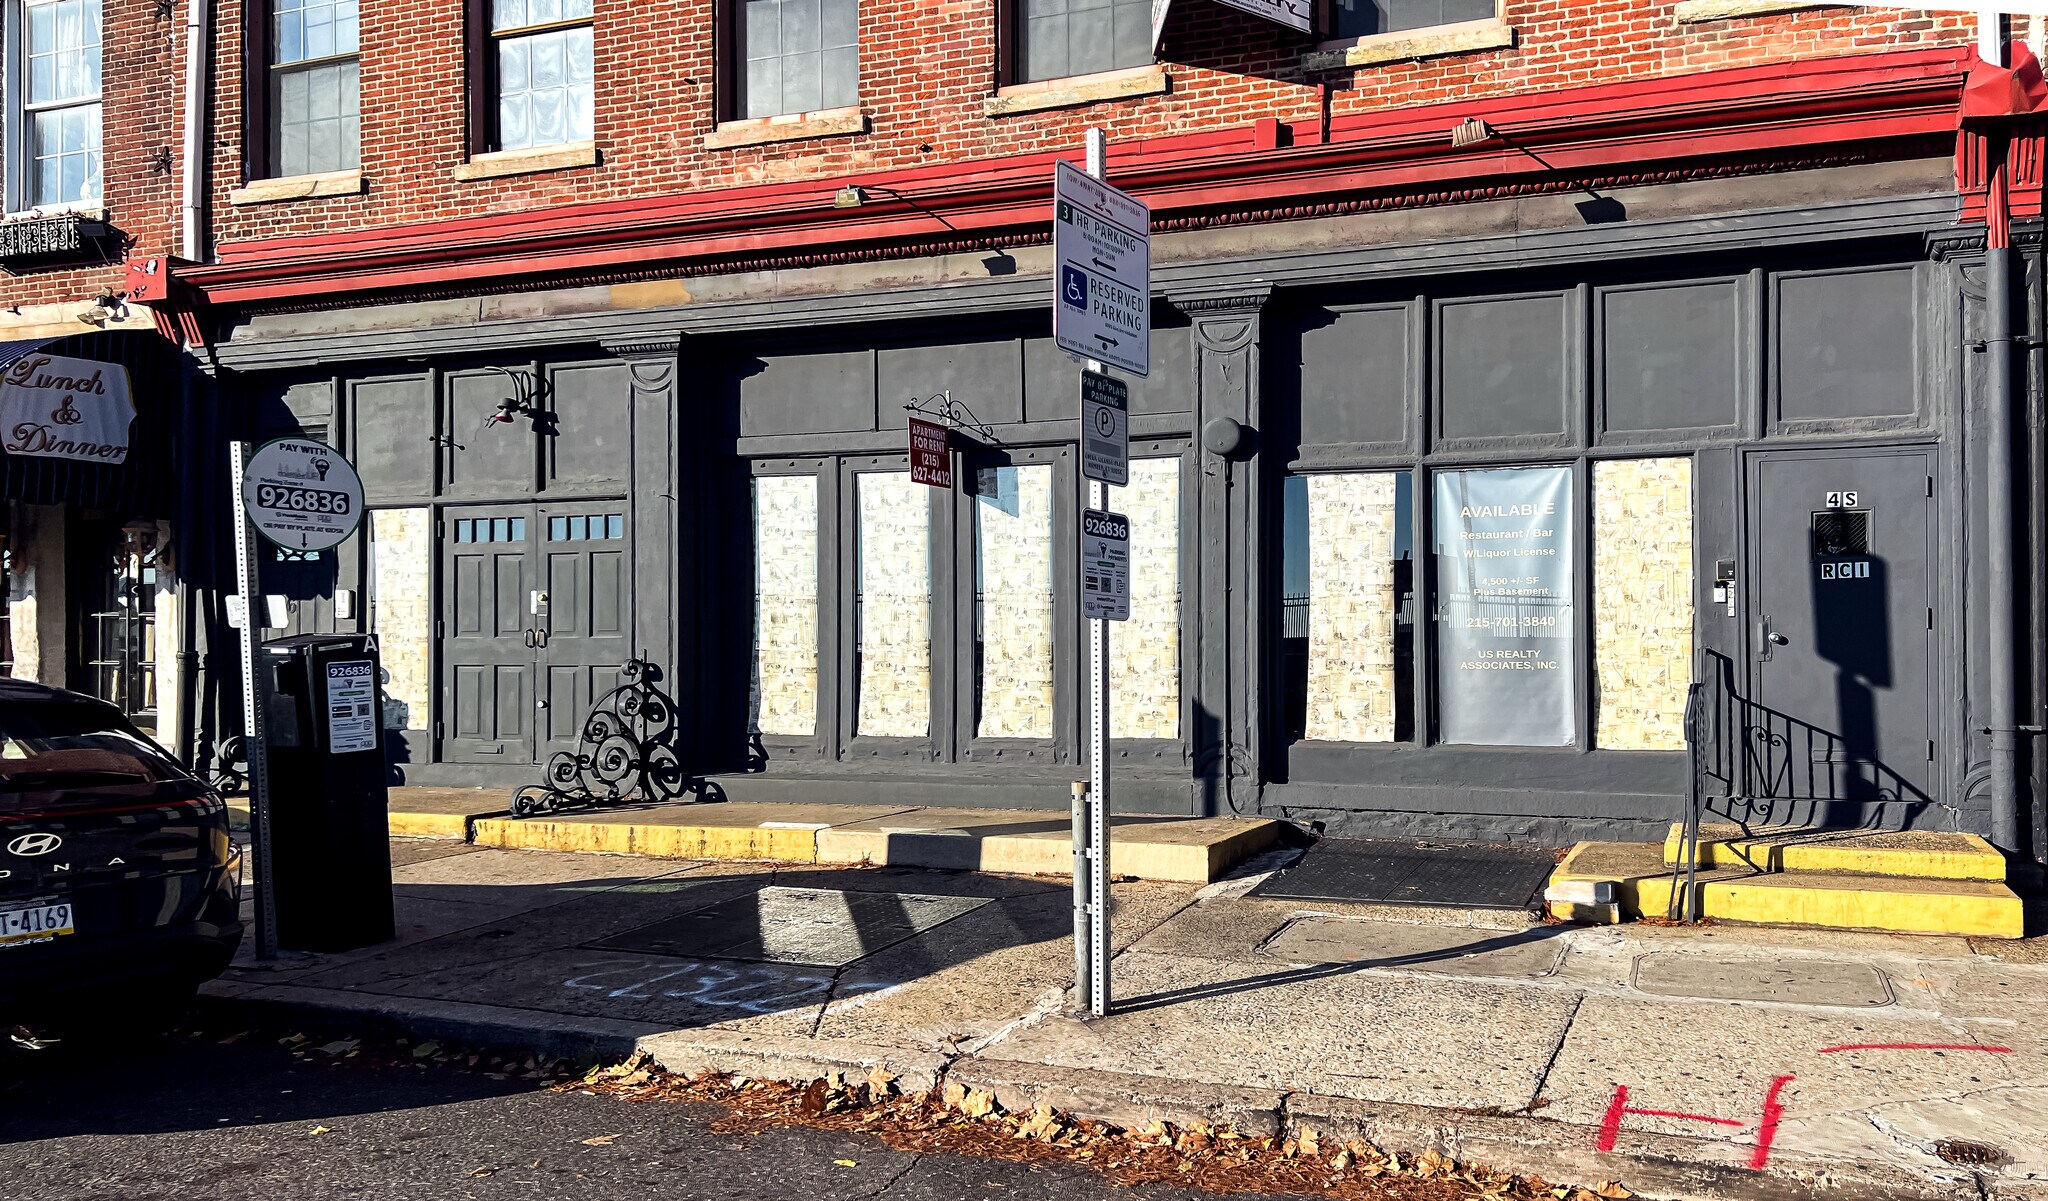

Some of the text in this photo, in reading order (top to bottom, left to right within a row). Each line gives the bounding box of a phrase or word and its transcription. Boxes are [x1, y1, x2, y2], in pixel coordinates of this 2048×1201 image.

[1063, 205, 1136, 252] 3 HR PARKING
[1090, 278, 1144, 313] RESERVED
[1094, 300, 1141, 331] PARKING
[5, 357, 105, 395] Lunch
[1083, 376, 1095, 388] PAY
[1109, 384, 1127, 398] PLATE
[1091, 391, 1119, 407] PARKING
[51, 395, 84, 425] &
[6, 422, 128, 458] Dinner
[913, 425, 946, 441] APARTMENT
[280, 443, 328, 456] PAY WITH
[914, 436, 945, 453] FOR RENT
[922, 452, 940, 468] (215)
[913, 466, 950, 485] 627-4412
[261, 486, 347, 513] 926836
[1460, 502, 1555, 518] AVAILABLE
[1085, 518, 1126, 538] 926836
[1460, 530, 1524, 541] Restaurant
[1532, 528, 1554, 538] Bar
[1463, 548, 1556, 559] W/Liquor License
[1481, 577, 1540, 586] 4,500 +/- SF
[1473, 587, 1549, 596] Plus Basement
[1466, 616, 1556, 628] 215-701-3840
[363, 635, 378, 652] A
[1478, 650, 1541, 659] US REALTY
[330, 665, 371, 677] 926836
[1460, 661, 1560, 671] ASSOCIATES, INC.
